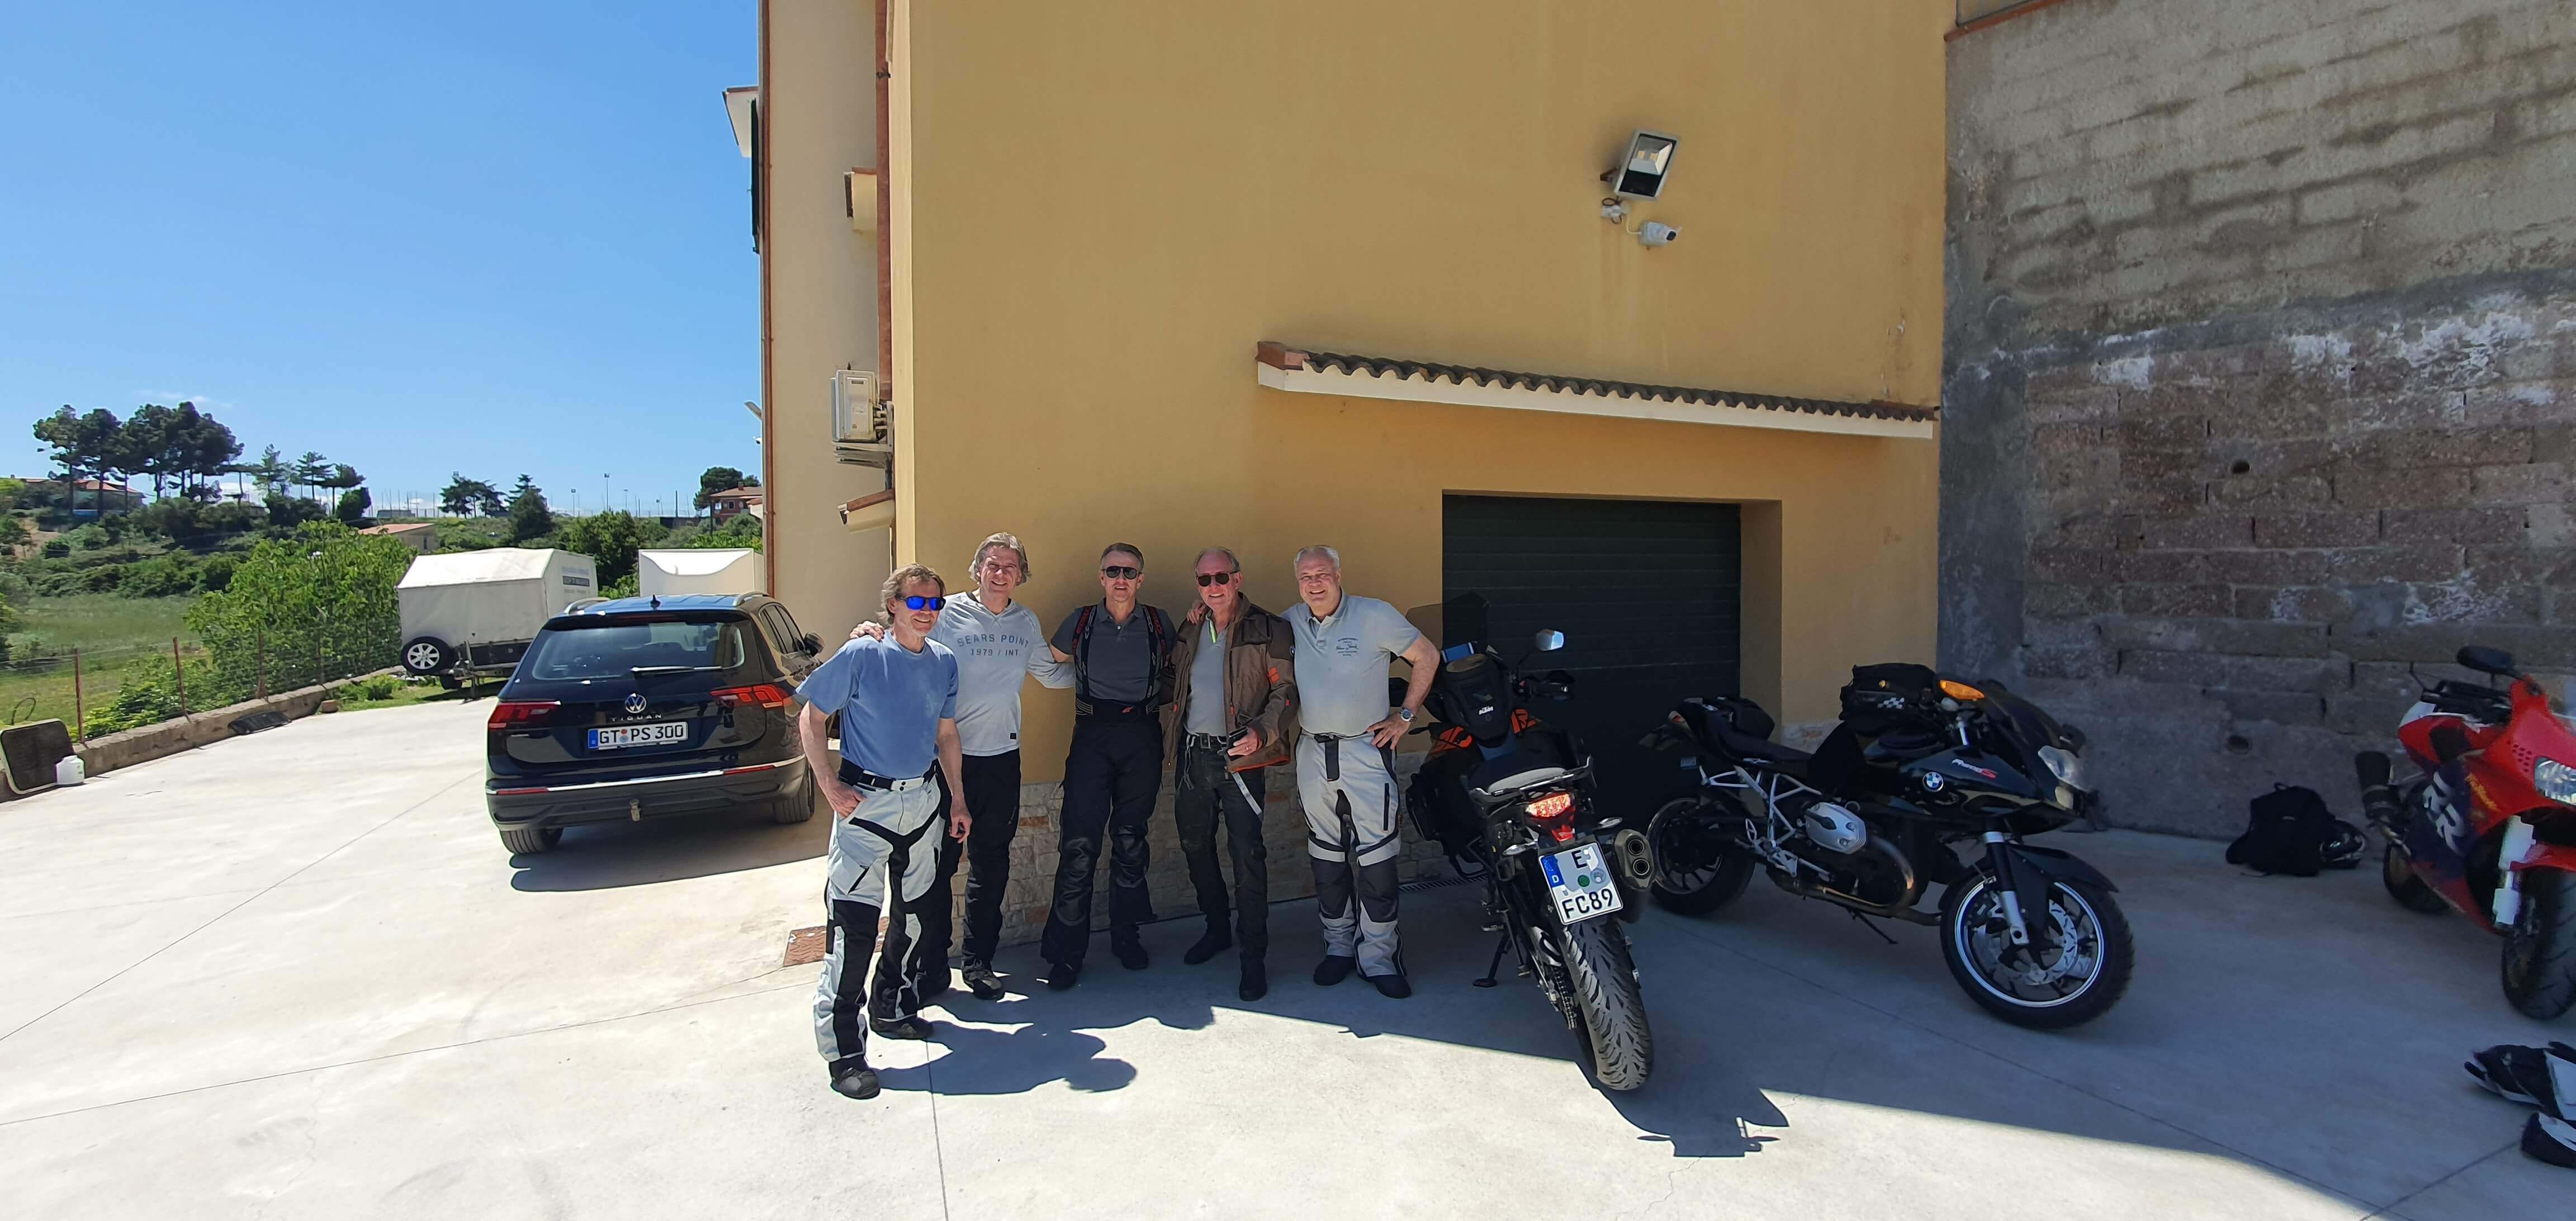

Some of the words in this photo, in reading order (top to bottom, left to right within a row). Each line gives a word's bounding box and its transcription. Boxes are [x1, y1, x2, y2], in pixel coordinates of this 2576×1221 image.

[957, 633, 995, 647] SEARS
[1001, 634, 1029, 647] POINT
[610, 714, 662, 722] TIGUAN
[599, 730, 620, 744] GT
[631, 727, 651, 741] PS
[655, 725, 684, 739] 300
[1571, 849, 1588, 869] E
[1552, 875, 1560, 883] D
[1562, 888, 1613, 919] FC89
